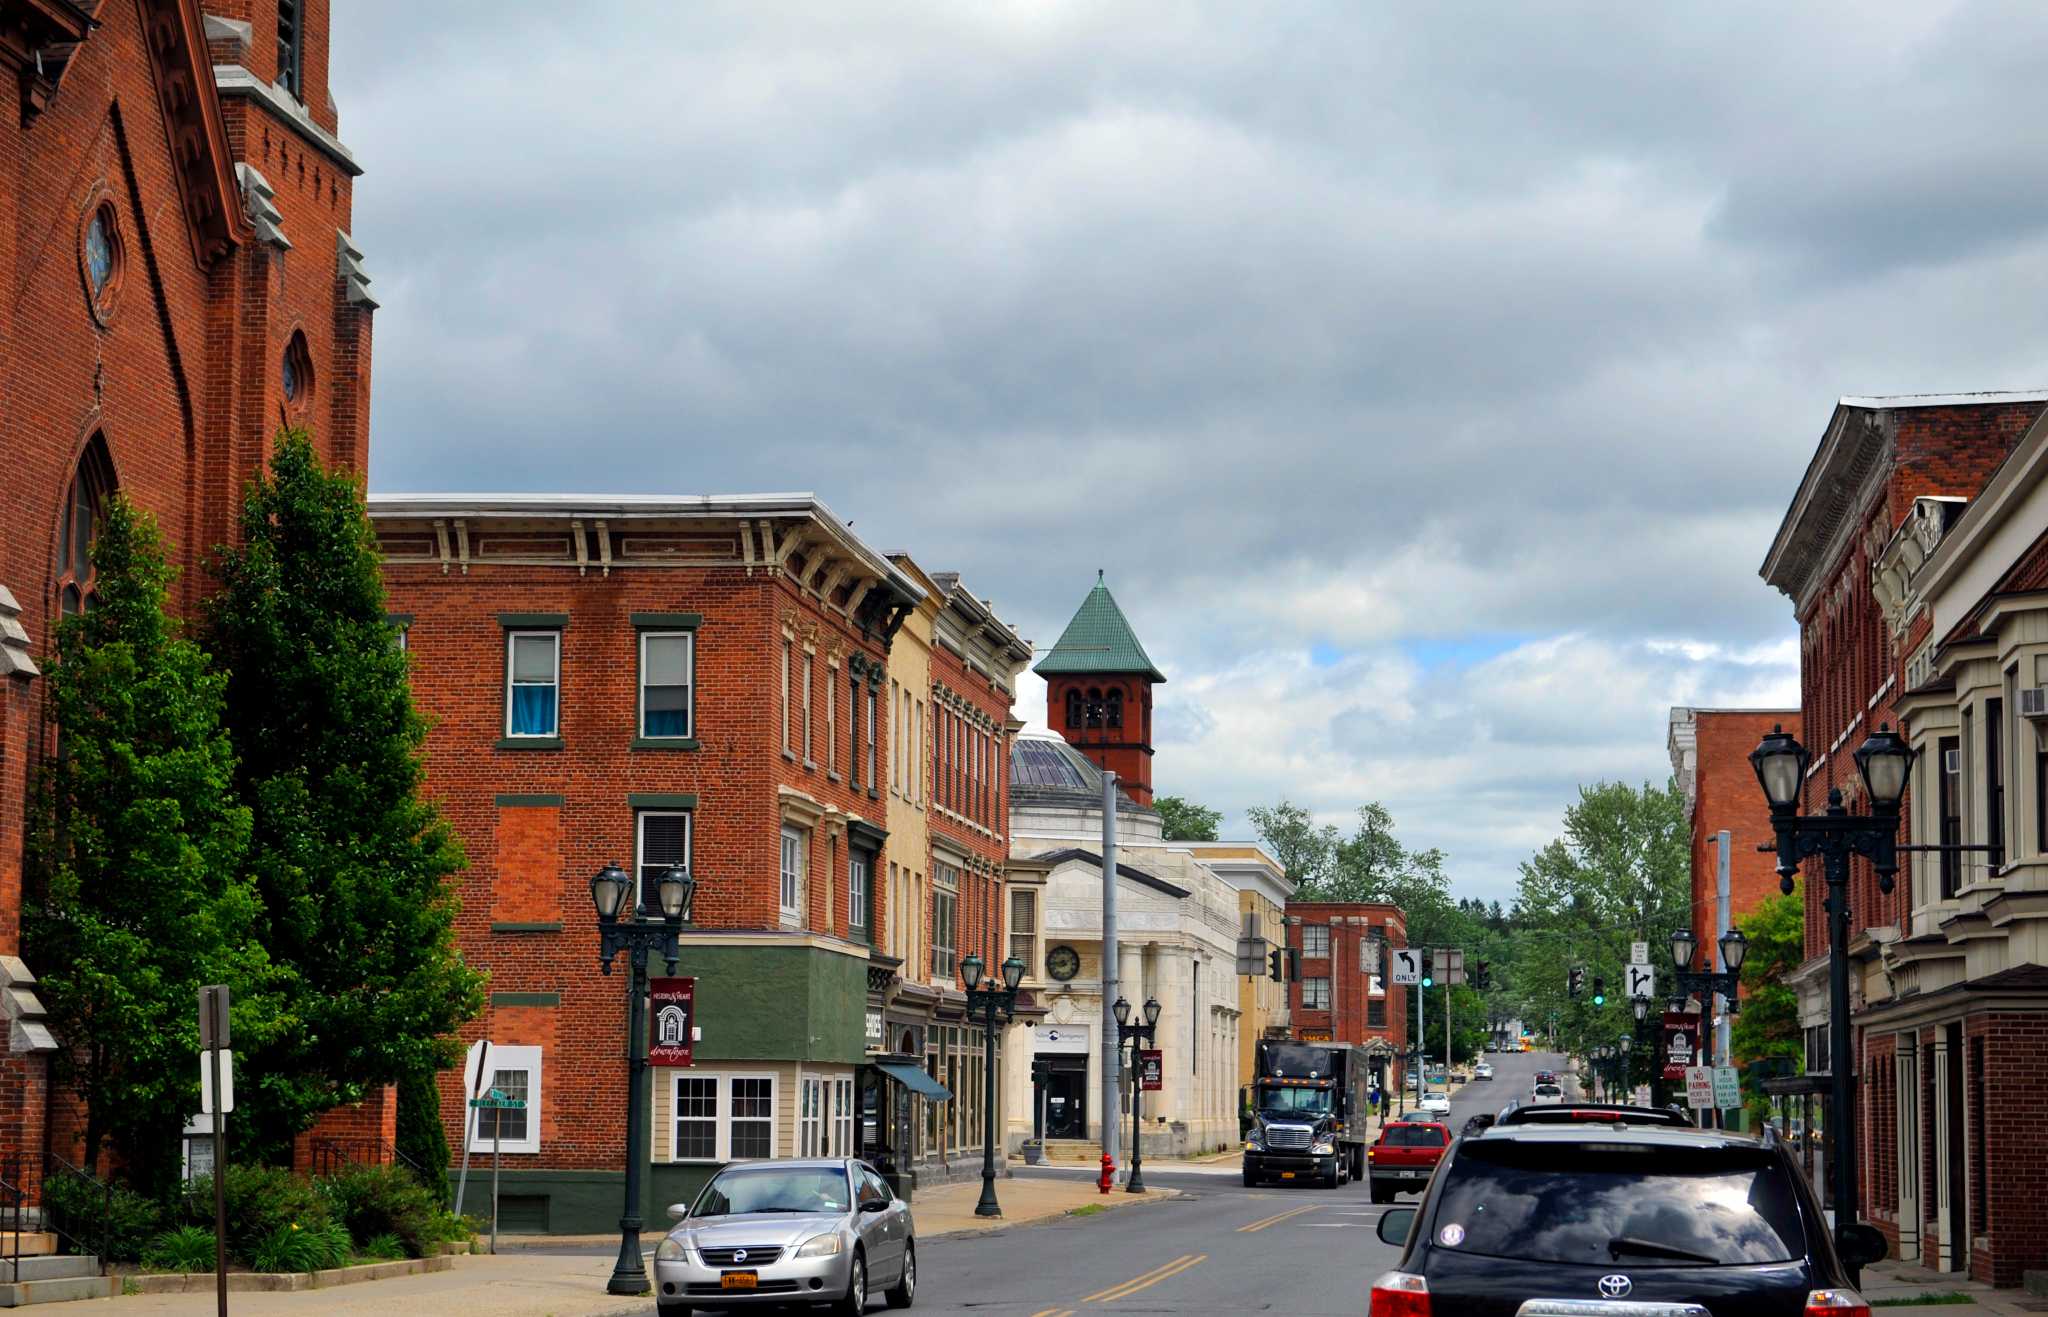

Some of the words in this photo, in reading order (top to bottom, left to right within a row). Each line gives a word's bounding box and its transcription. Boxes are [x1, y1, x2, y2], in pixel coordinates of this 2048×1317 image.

[1395, 974, 1417, 982] ONLY
[650, 1045, 690, 1062] downtown
[1693, 1072, 1704, 1081] NO
[1688, 1081, 1712, 1090] PARKING
